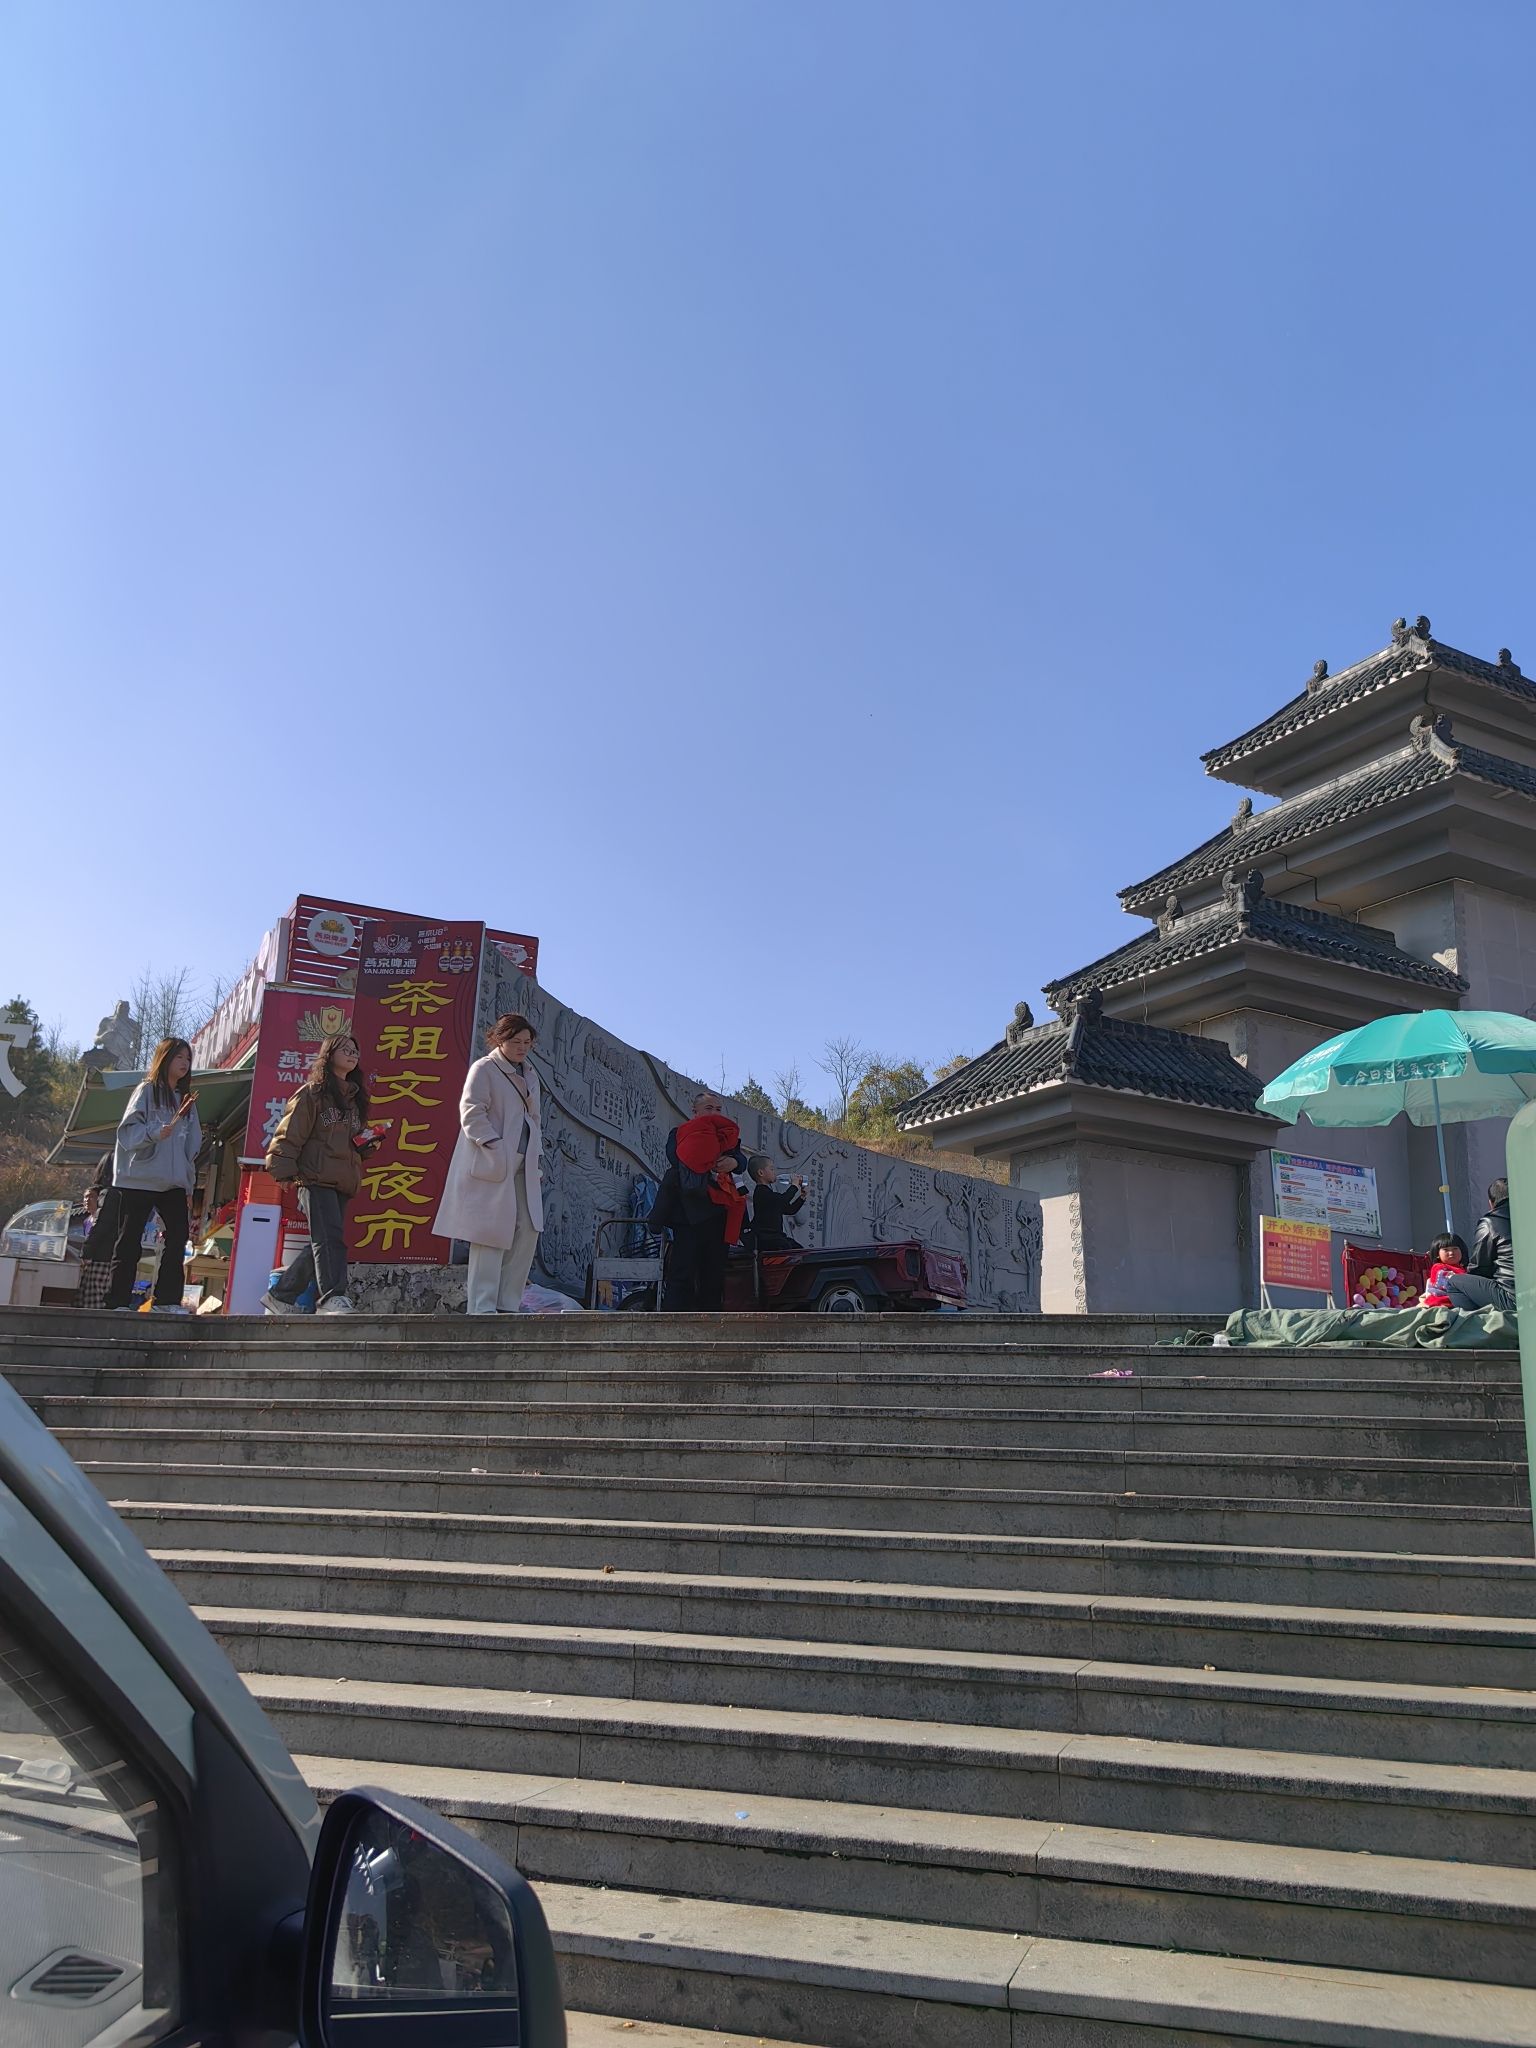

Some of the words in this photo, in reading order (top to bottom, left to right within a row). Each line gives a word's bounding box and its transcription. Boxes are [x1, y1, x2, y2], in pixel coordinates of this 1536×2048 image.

[364, 957, 418, 968] 燕京啤酒
[277, 1071, 309, 1083] YAN
[353, 979, 455, 1252] 茶祖文化夜市
